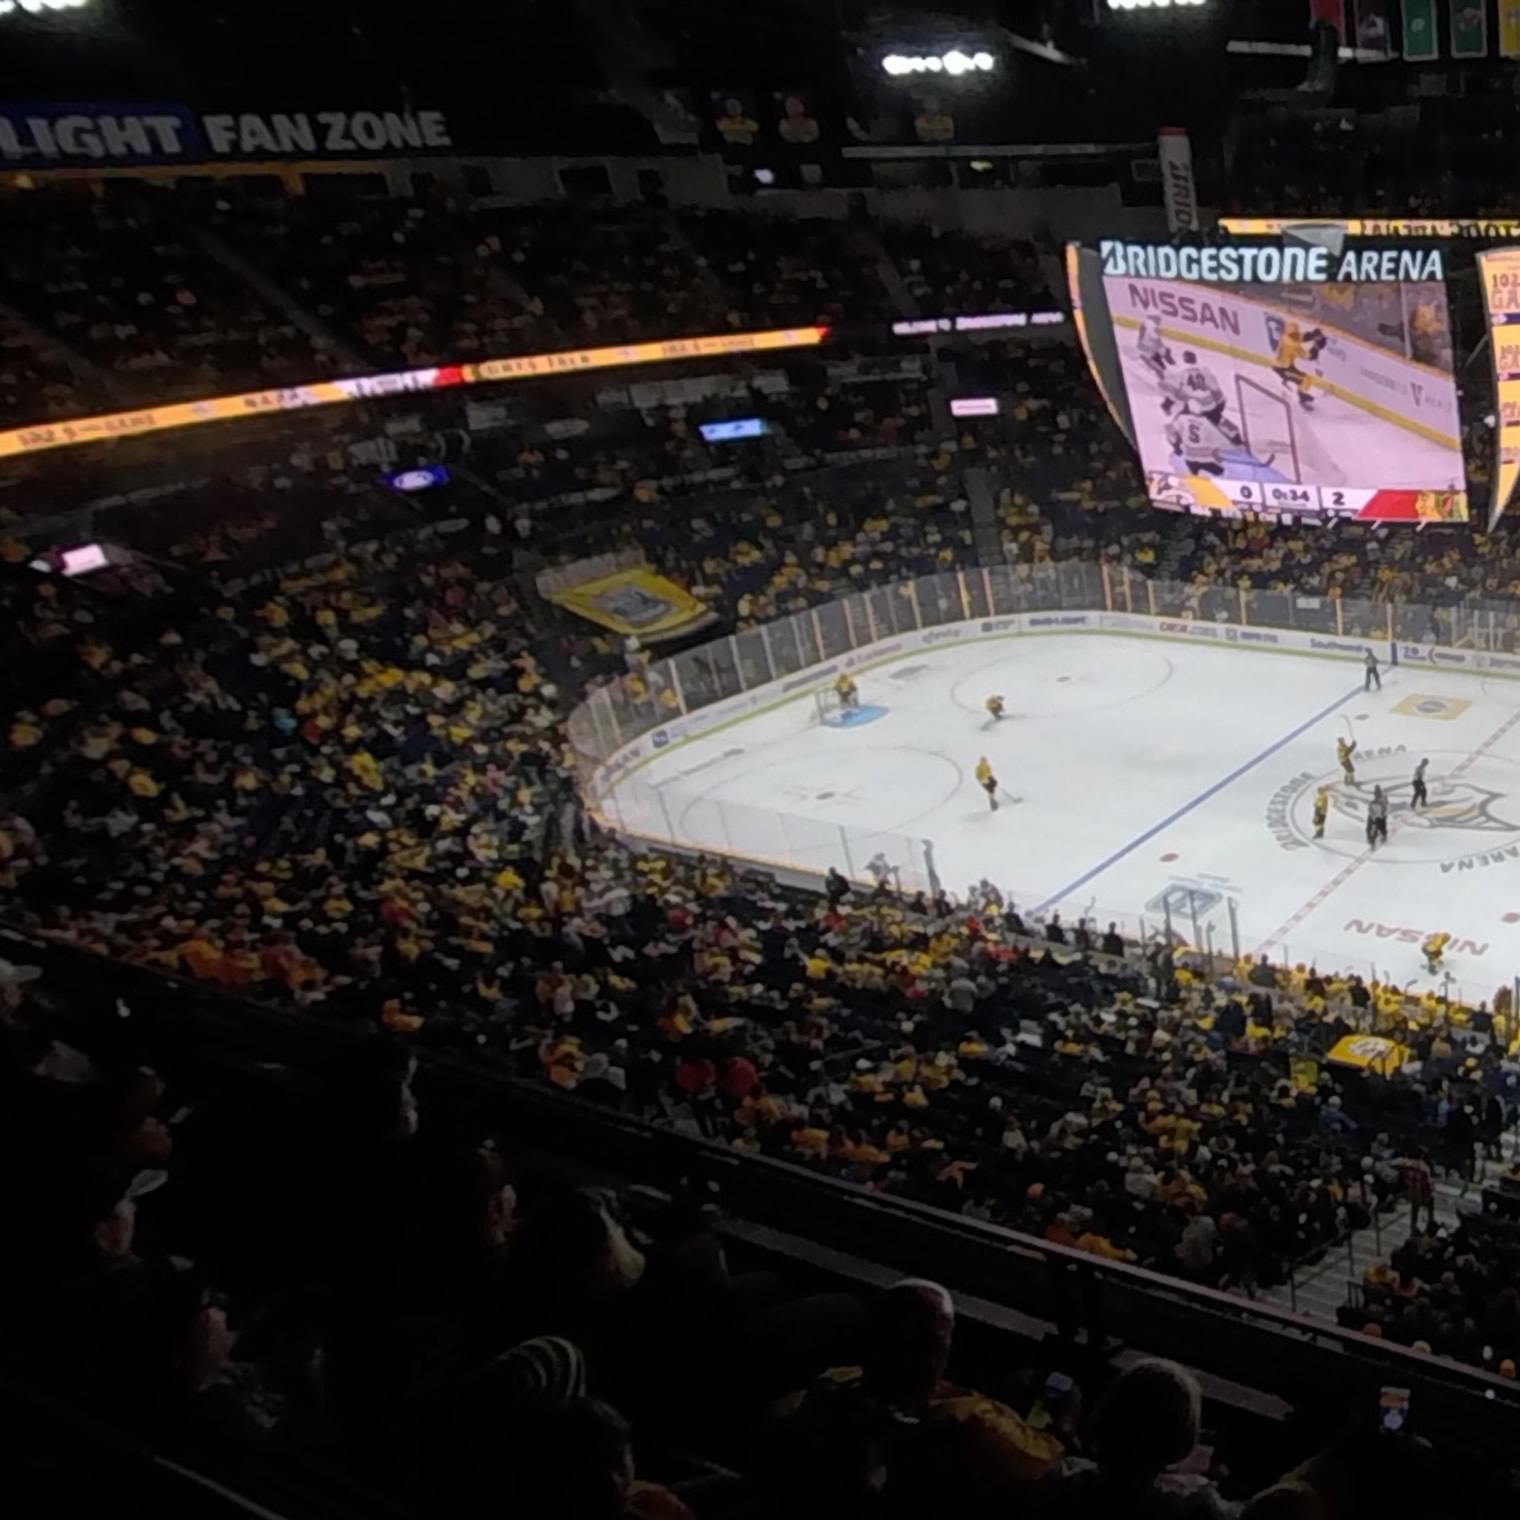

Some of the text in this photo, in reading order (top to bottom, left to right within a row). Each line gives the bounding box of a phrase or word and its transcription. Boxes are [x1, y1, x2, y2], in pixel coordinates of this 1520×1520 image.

[0, 110, 452, 160] LIGHT FAN ZONE
[1101, 240, 1444, 282] BRIDGESTONE ARENA
[1127, 283, 1241, 336] NISSAN
[1240, 486, 1345, 505] 0 0:34 2
[1310, 638, 1364, 654] Southwest
[1439, 846, 1520, 874] ARENA
